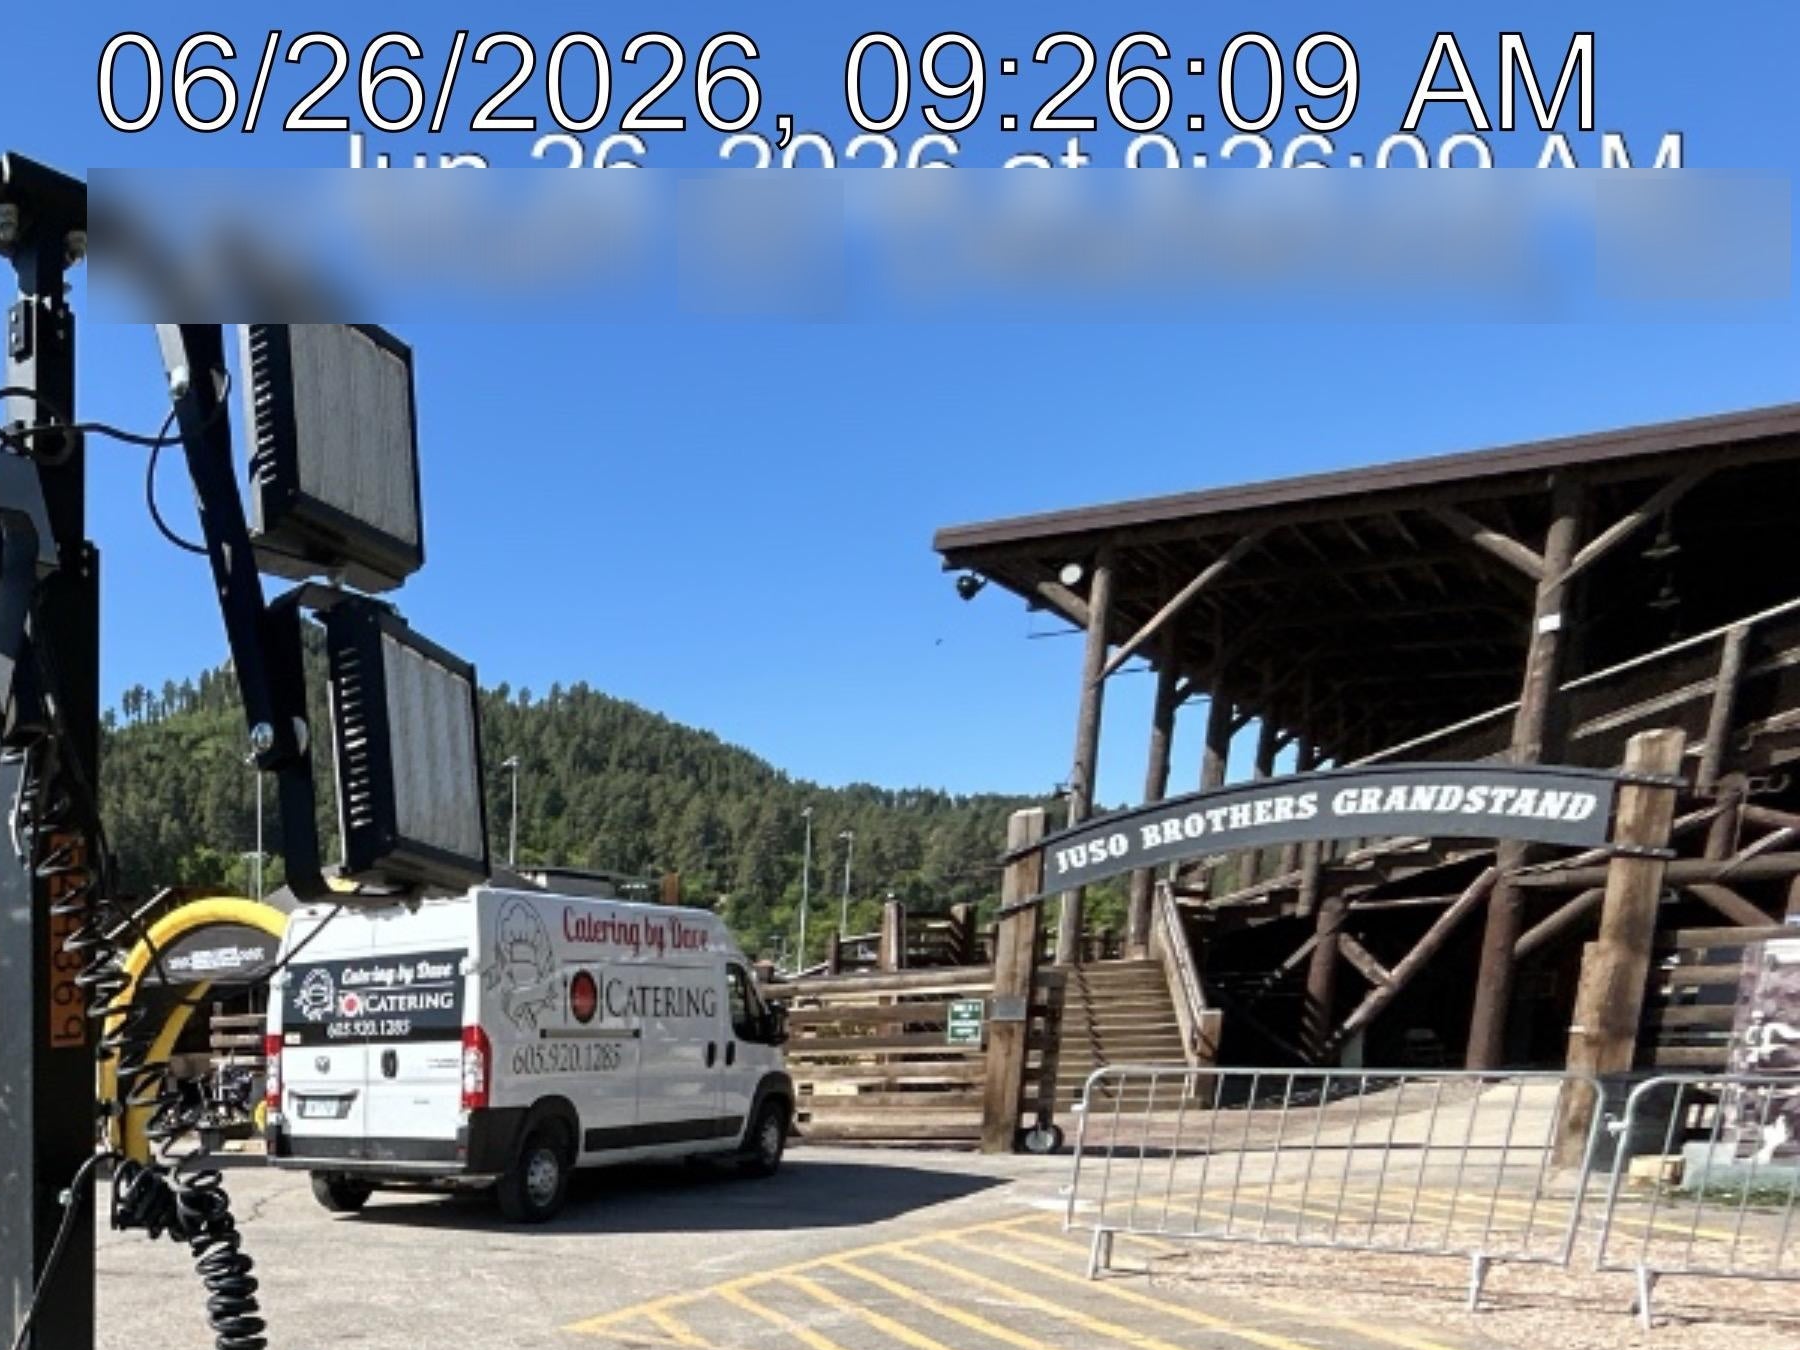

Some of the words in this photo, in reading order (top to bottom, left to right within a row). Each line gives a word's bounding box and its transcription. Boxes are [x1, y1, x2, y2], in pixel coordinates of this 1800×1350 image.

[1139, 791, 1319, 850] BROTHERS
[1331, 783, 1598, 821] GRANDSTAND
[563, 905, 640, 956] Catering
[645, 917, 664, 957] by
